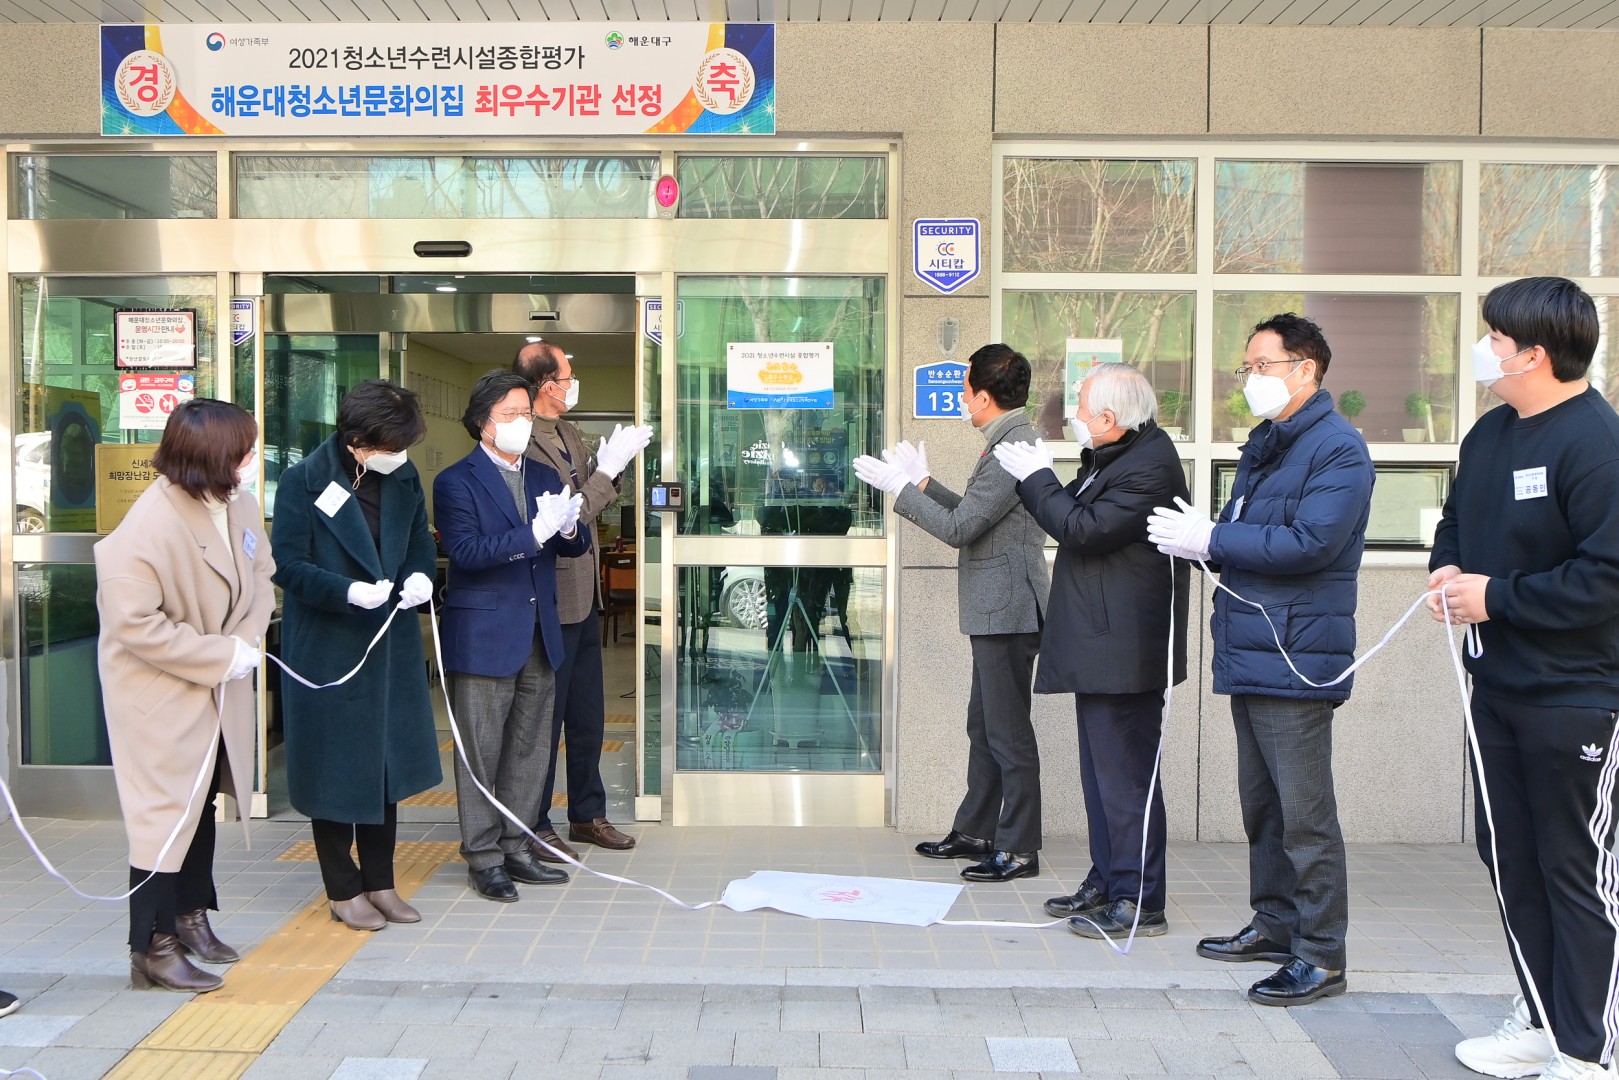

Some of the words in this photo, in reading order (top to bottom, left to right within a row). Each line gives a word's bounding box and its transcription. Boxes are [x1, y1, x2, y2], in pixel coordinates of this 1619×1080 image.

[229, 37, 270, 47] 여성가족부
[628, 36, 672, 47] 해운대구
[288, 46, 586, 71] 2021청소년수련시설종합평가
[129, 63, 159, 103] 경
[706, 62, 740, 101] 축
[210, 84, 465, 118] 해운대청소년문화의집
[474, 83, 602, 117] 최우수기관
[611, 83, 663, 117] 선정
[921, 226, 972, 235] SECURITY
[929, 258, 965, 269] 시티캅
[108, 471, 151, 481] 희망장난감
